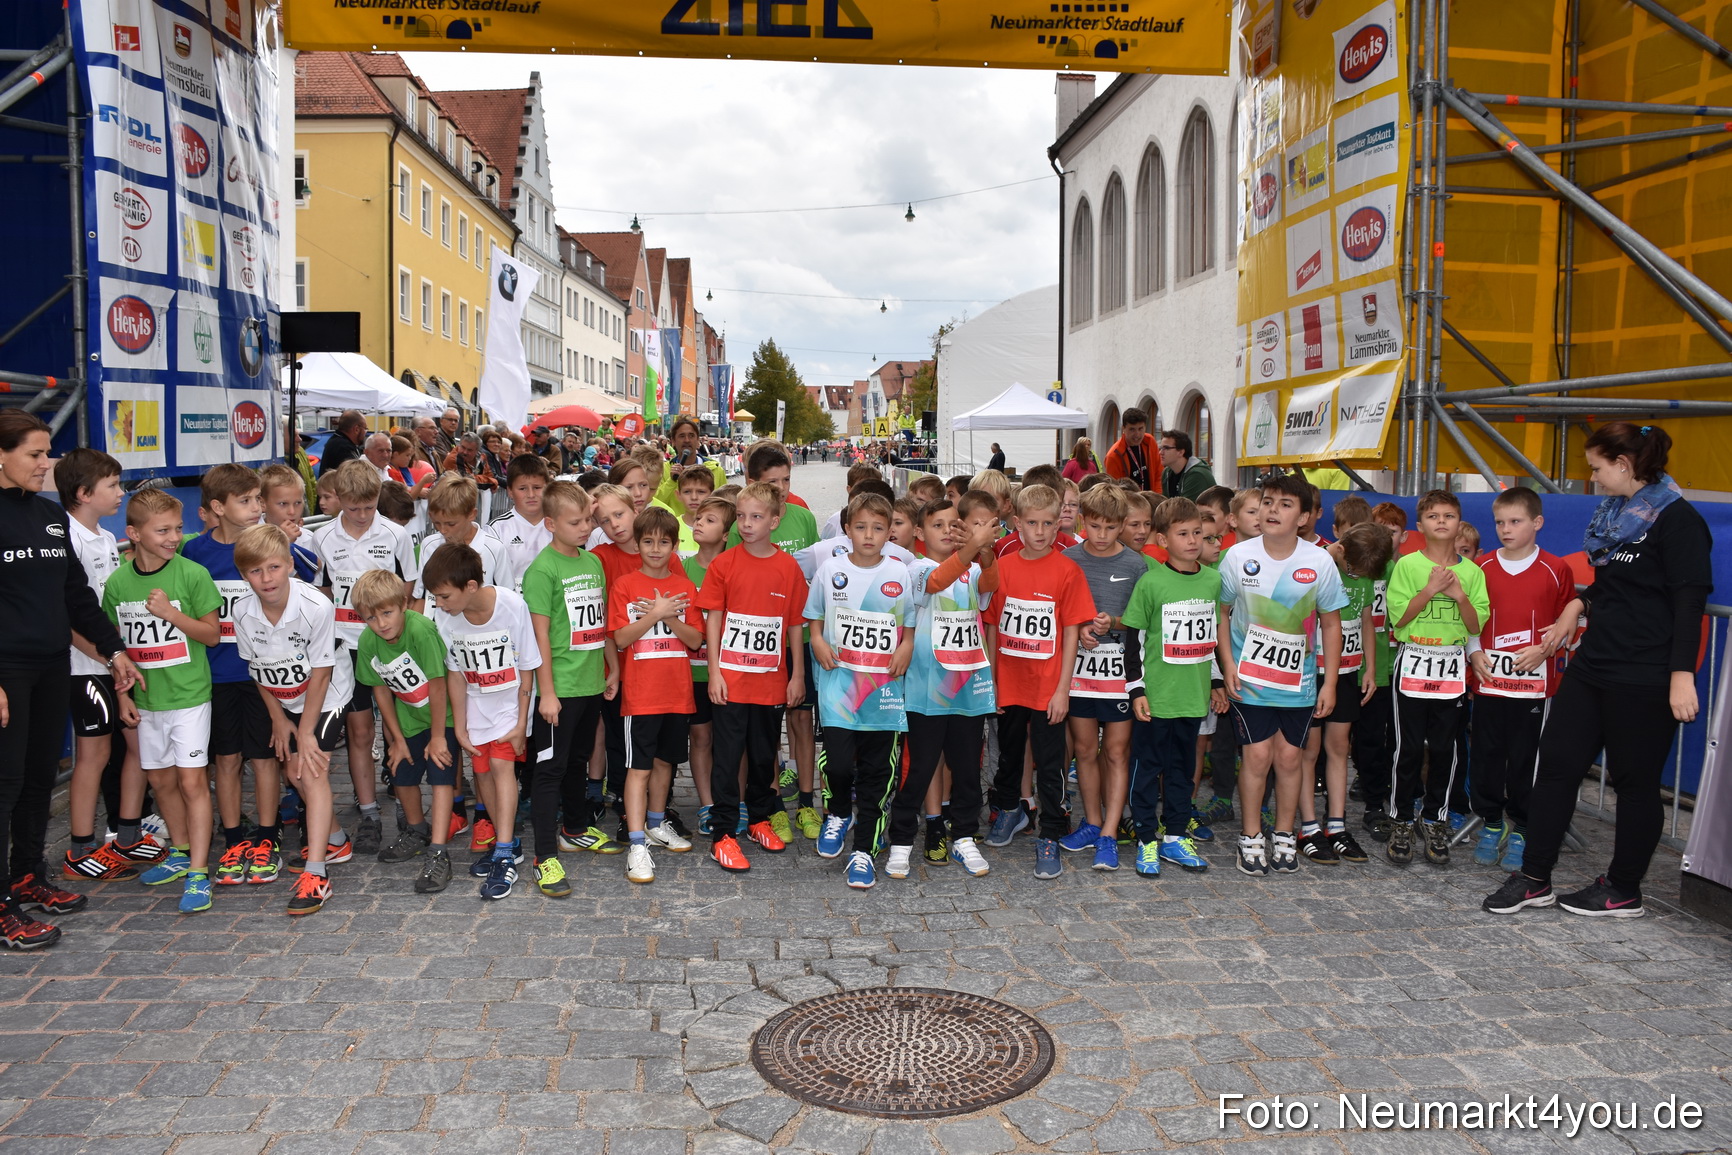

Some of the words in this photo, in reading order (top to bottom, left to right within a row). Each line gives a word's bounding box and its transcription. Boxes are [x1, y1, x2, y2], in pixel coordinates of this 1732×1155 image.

[989, 15, 1099, 30] Neumarkter
[1104, 16, 1185, 33] Stadtlauf
[1345, 36, 1383, 71] Hervis
[1366, 129, 1392, 146] Tagblatt
[1346, 218, 1382, 248] Hervis
[124, 242, 138, 258] KIA
[113, 306, 151, 340] Hervis
[1355, 329, 1390, 343] Neumarkter
[1350, 341, 1397, 360] Lammsbräu
[1285, 410, 1314, 430] swn
[1341, 402, 1386, 423] NATHUS
[234, 411, 264, 437] Hervis
[879, 423, 886, 433] A
[137, 435, 157, 447] KANN
[4, 547, 33, 562] get
[728, 618, 744, 626] PARTL
[837, 614, 856, 622] PARTL
[857, 617, 888, 625] Neumarkt
[1004, 611, 1051, 637] 7169
[124, 620, 178, 644] 7212
[841, 624, 891, 651] 7555
[940, 625, 979, 648] 7413
[1170, 618, 1212, 641] 7137
[467, 638, 498, 647] Neumarkt
[654, 641, 670, 650] Fati
[729, 627, 777, 652] 7186
[1007, 639, 1040, 650] Walfried
[1249, 630, 1270, 641] PARTL
[1271, 637, 1300, 647] Neumarkt
[1503, 635, 1521, 643] DEHN
[138, 651, 164, 660] Kenny
[1251, 640, 1301, 670] 7409
[1406, 646, 1426, 654] PARTL
[742, 655, 757, 664] Tim
[1076, 655, 1123, 677] 7445
[1410, 655, 1458, 677] 7114
[250, 664, 307, 686] 7028
[383, 668, 420, 690] 418
[881, 688, 893, 697] 16.
[1424, 682, 1440, 691] Max
[1493, 680, 1534, 690] Sebastian
